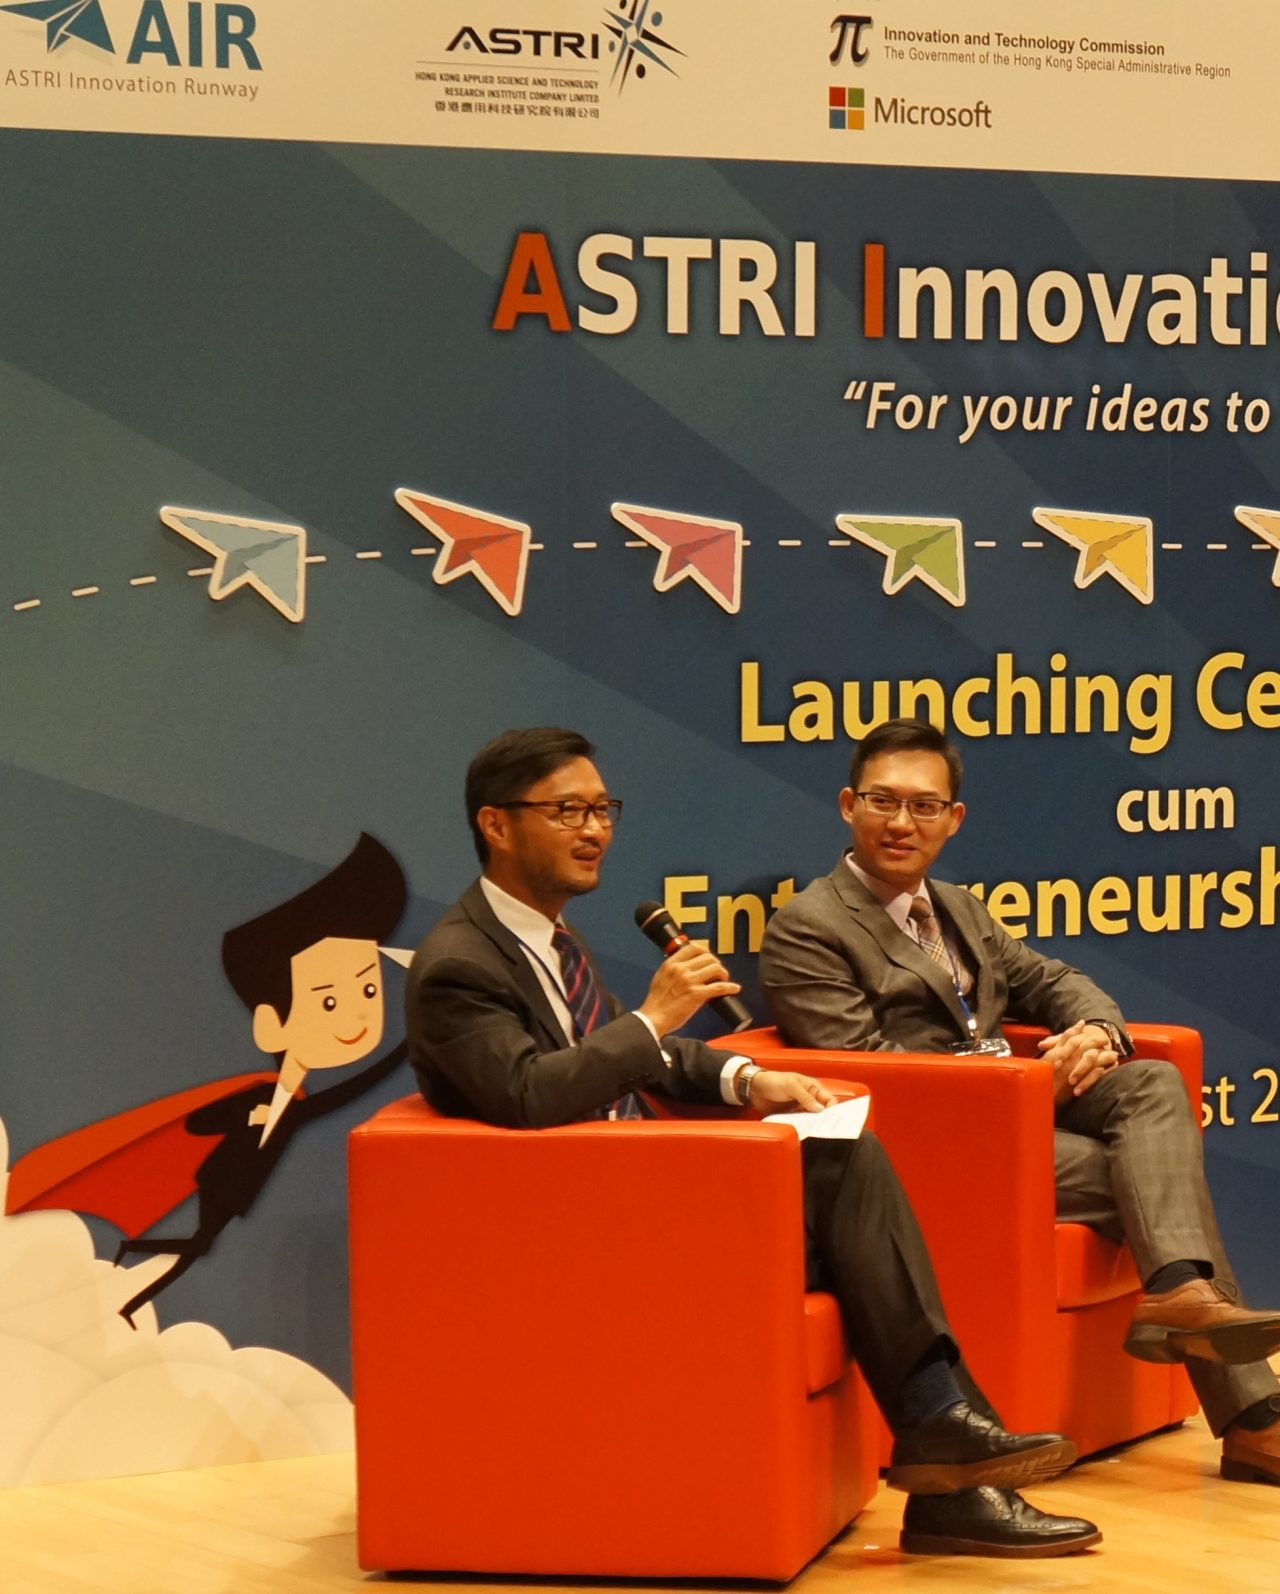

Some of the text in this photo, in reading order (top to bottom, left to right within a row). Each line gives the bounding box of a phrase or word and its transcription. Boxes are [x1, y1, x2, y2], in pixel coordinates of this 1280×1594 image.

[126, 0, 263, 71] AIR
[445, 26, 599, 59] ASTRI
[884, 26, 1165, 56] Innovation and Technology Commission
[884, 46, 1231, 79] The Government of the Hong Kong Special Administrative Region
[5, 69, 259, 102] ASTRI Innovation Runway
[415, 71, 599, 89] HONG KONG APPLIED SCIENCE AND TECHNOLOGY
[445, 87, 600, 103] RESEARCH INSTITUTE COMPANY LIMITED
[874, 97, 992, 128] Microsoft
[491, 231, 816, 337] ASTRI
[842, 380, 947, 430] “For
[958, 394, 1072, 444] your
[1085, 382, 1210, 433] ideas
[1225, 390, 1271, 434] to
[740, 652, 1173, 755] Launching
[1116, 786, 1236, 833] cum
